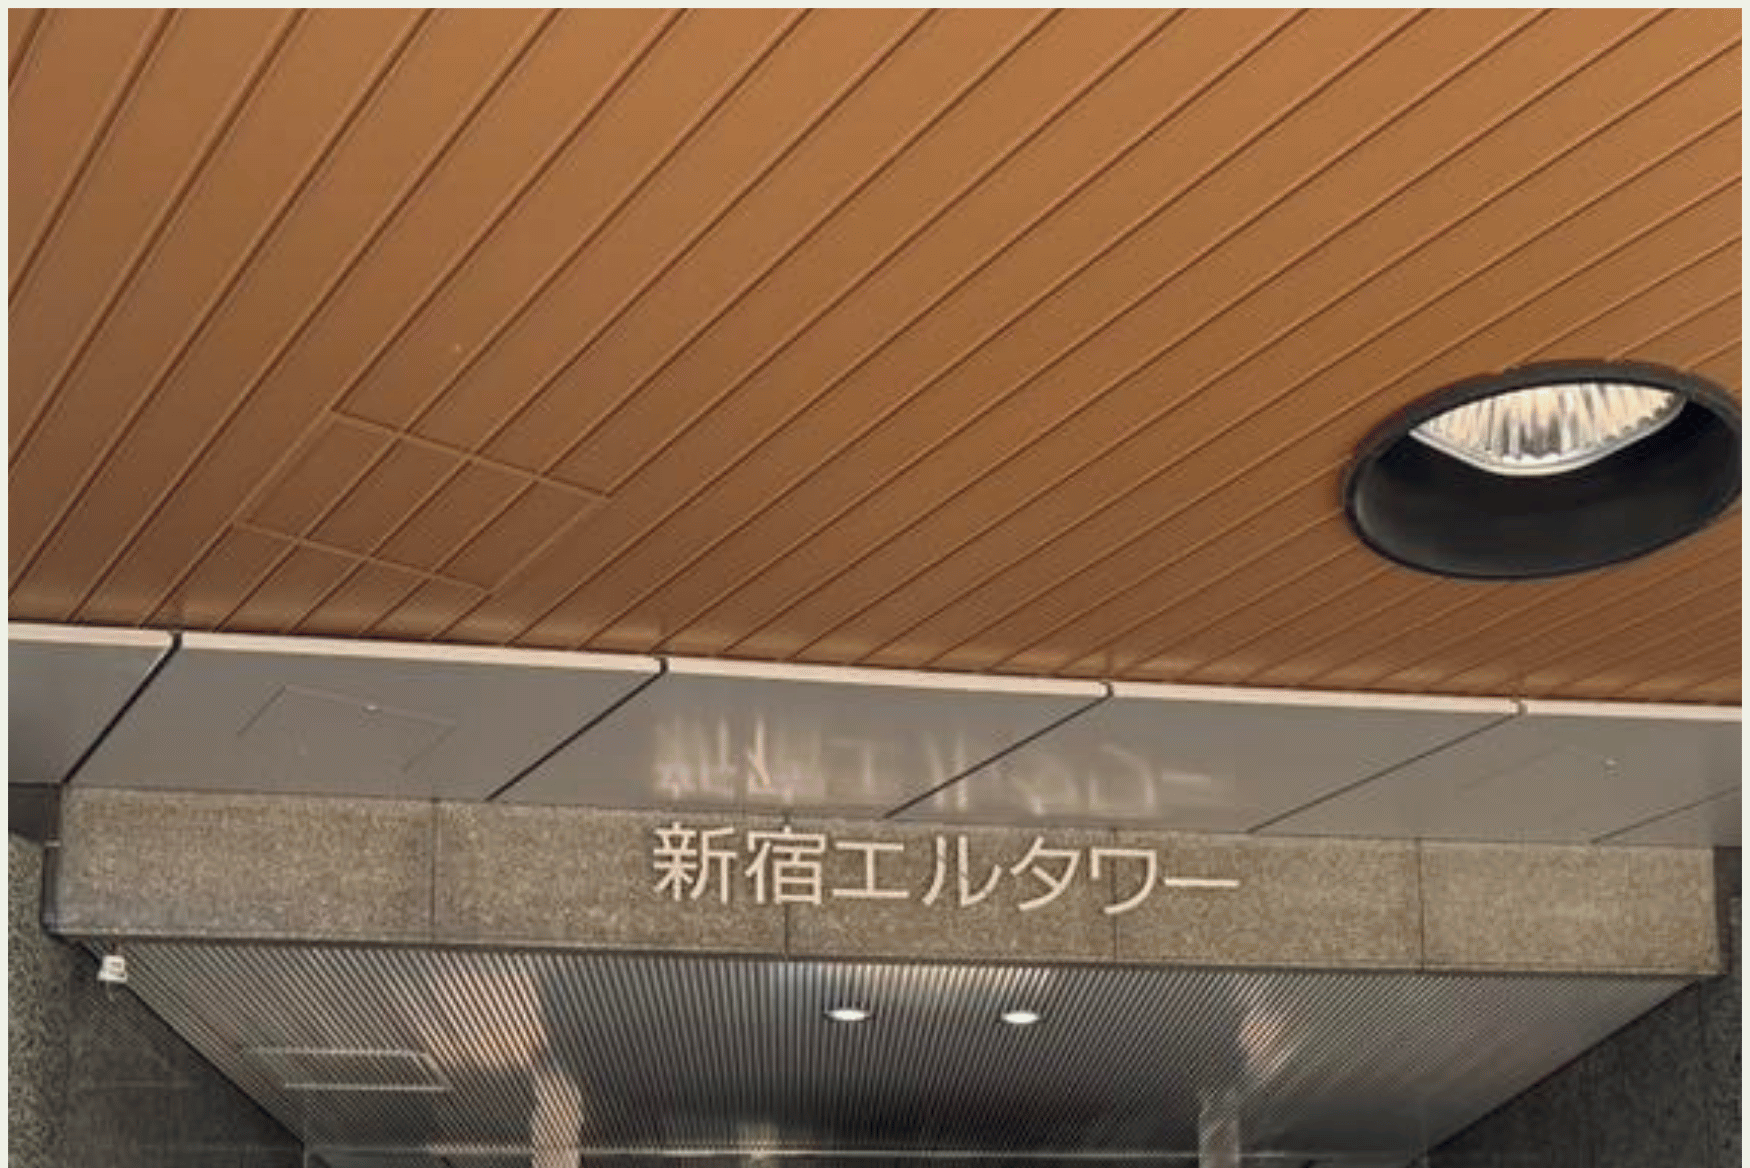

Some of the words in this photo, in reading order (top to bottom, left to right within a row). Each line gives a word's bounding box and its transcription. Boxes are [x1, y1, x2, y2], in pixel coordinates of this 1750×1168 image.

[653, 821, 1240, 914] 新宿エルタワー
